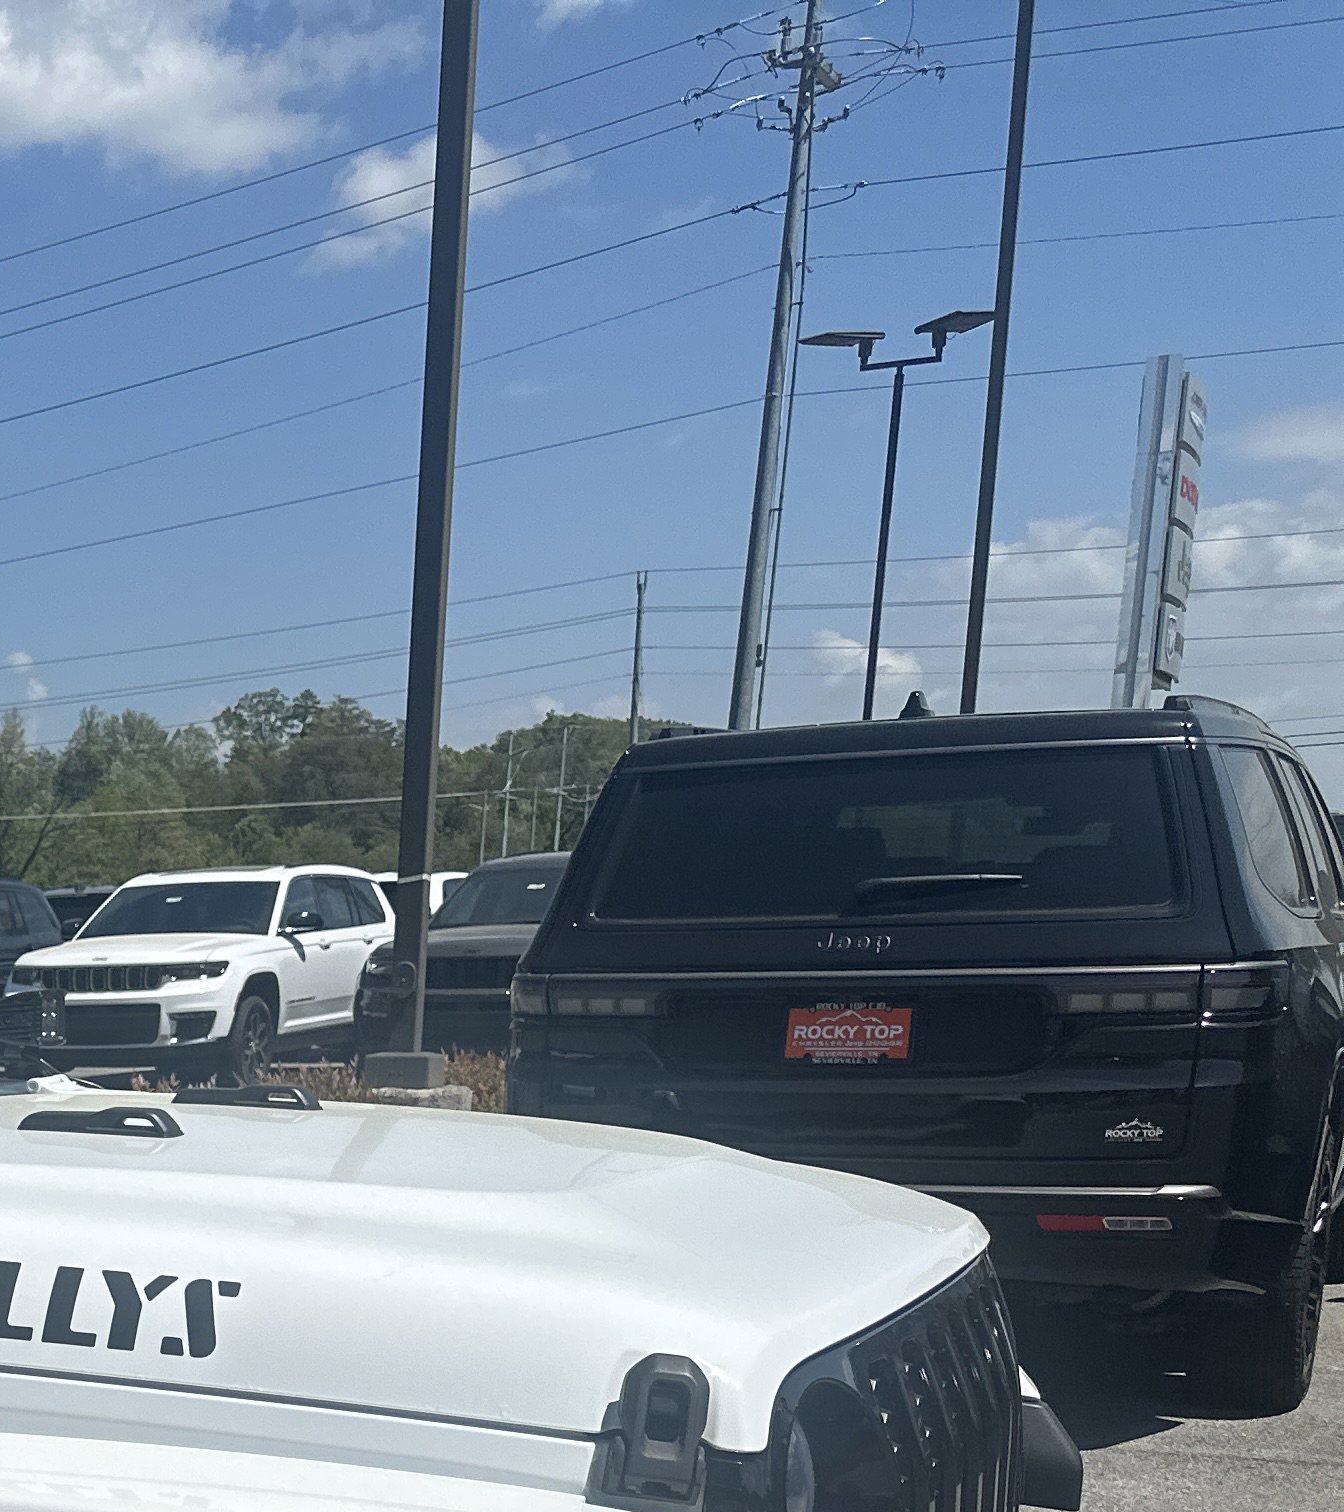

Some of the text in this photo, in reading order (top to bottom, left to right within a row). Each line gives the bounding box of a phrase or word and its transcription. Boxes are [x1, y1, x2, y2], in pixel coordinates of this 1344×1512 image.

[817, 932, 891, 953] Jeep
[794, 1025, 903, 1039] ROCKY TOP
[1105, 1128, 1164, 1137] ROCKY TOP
